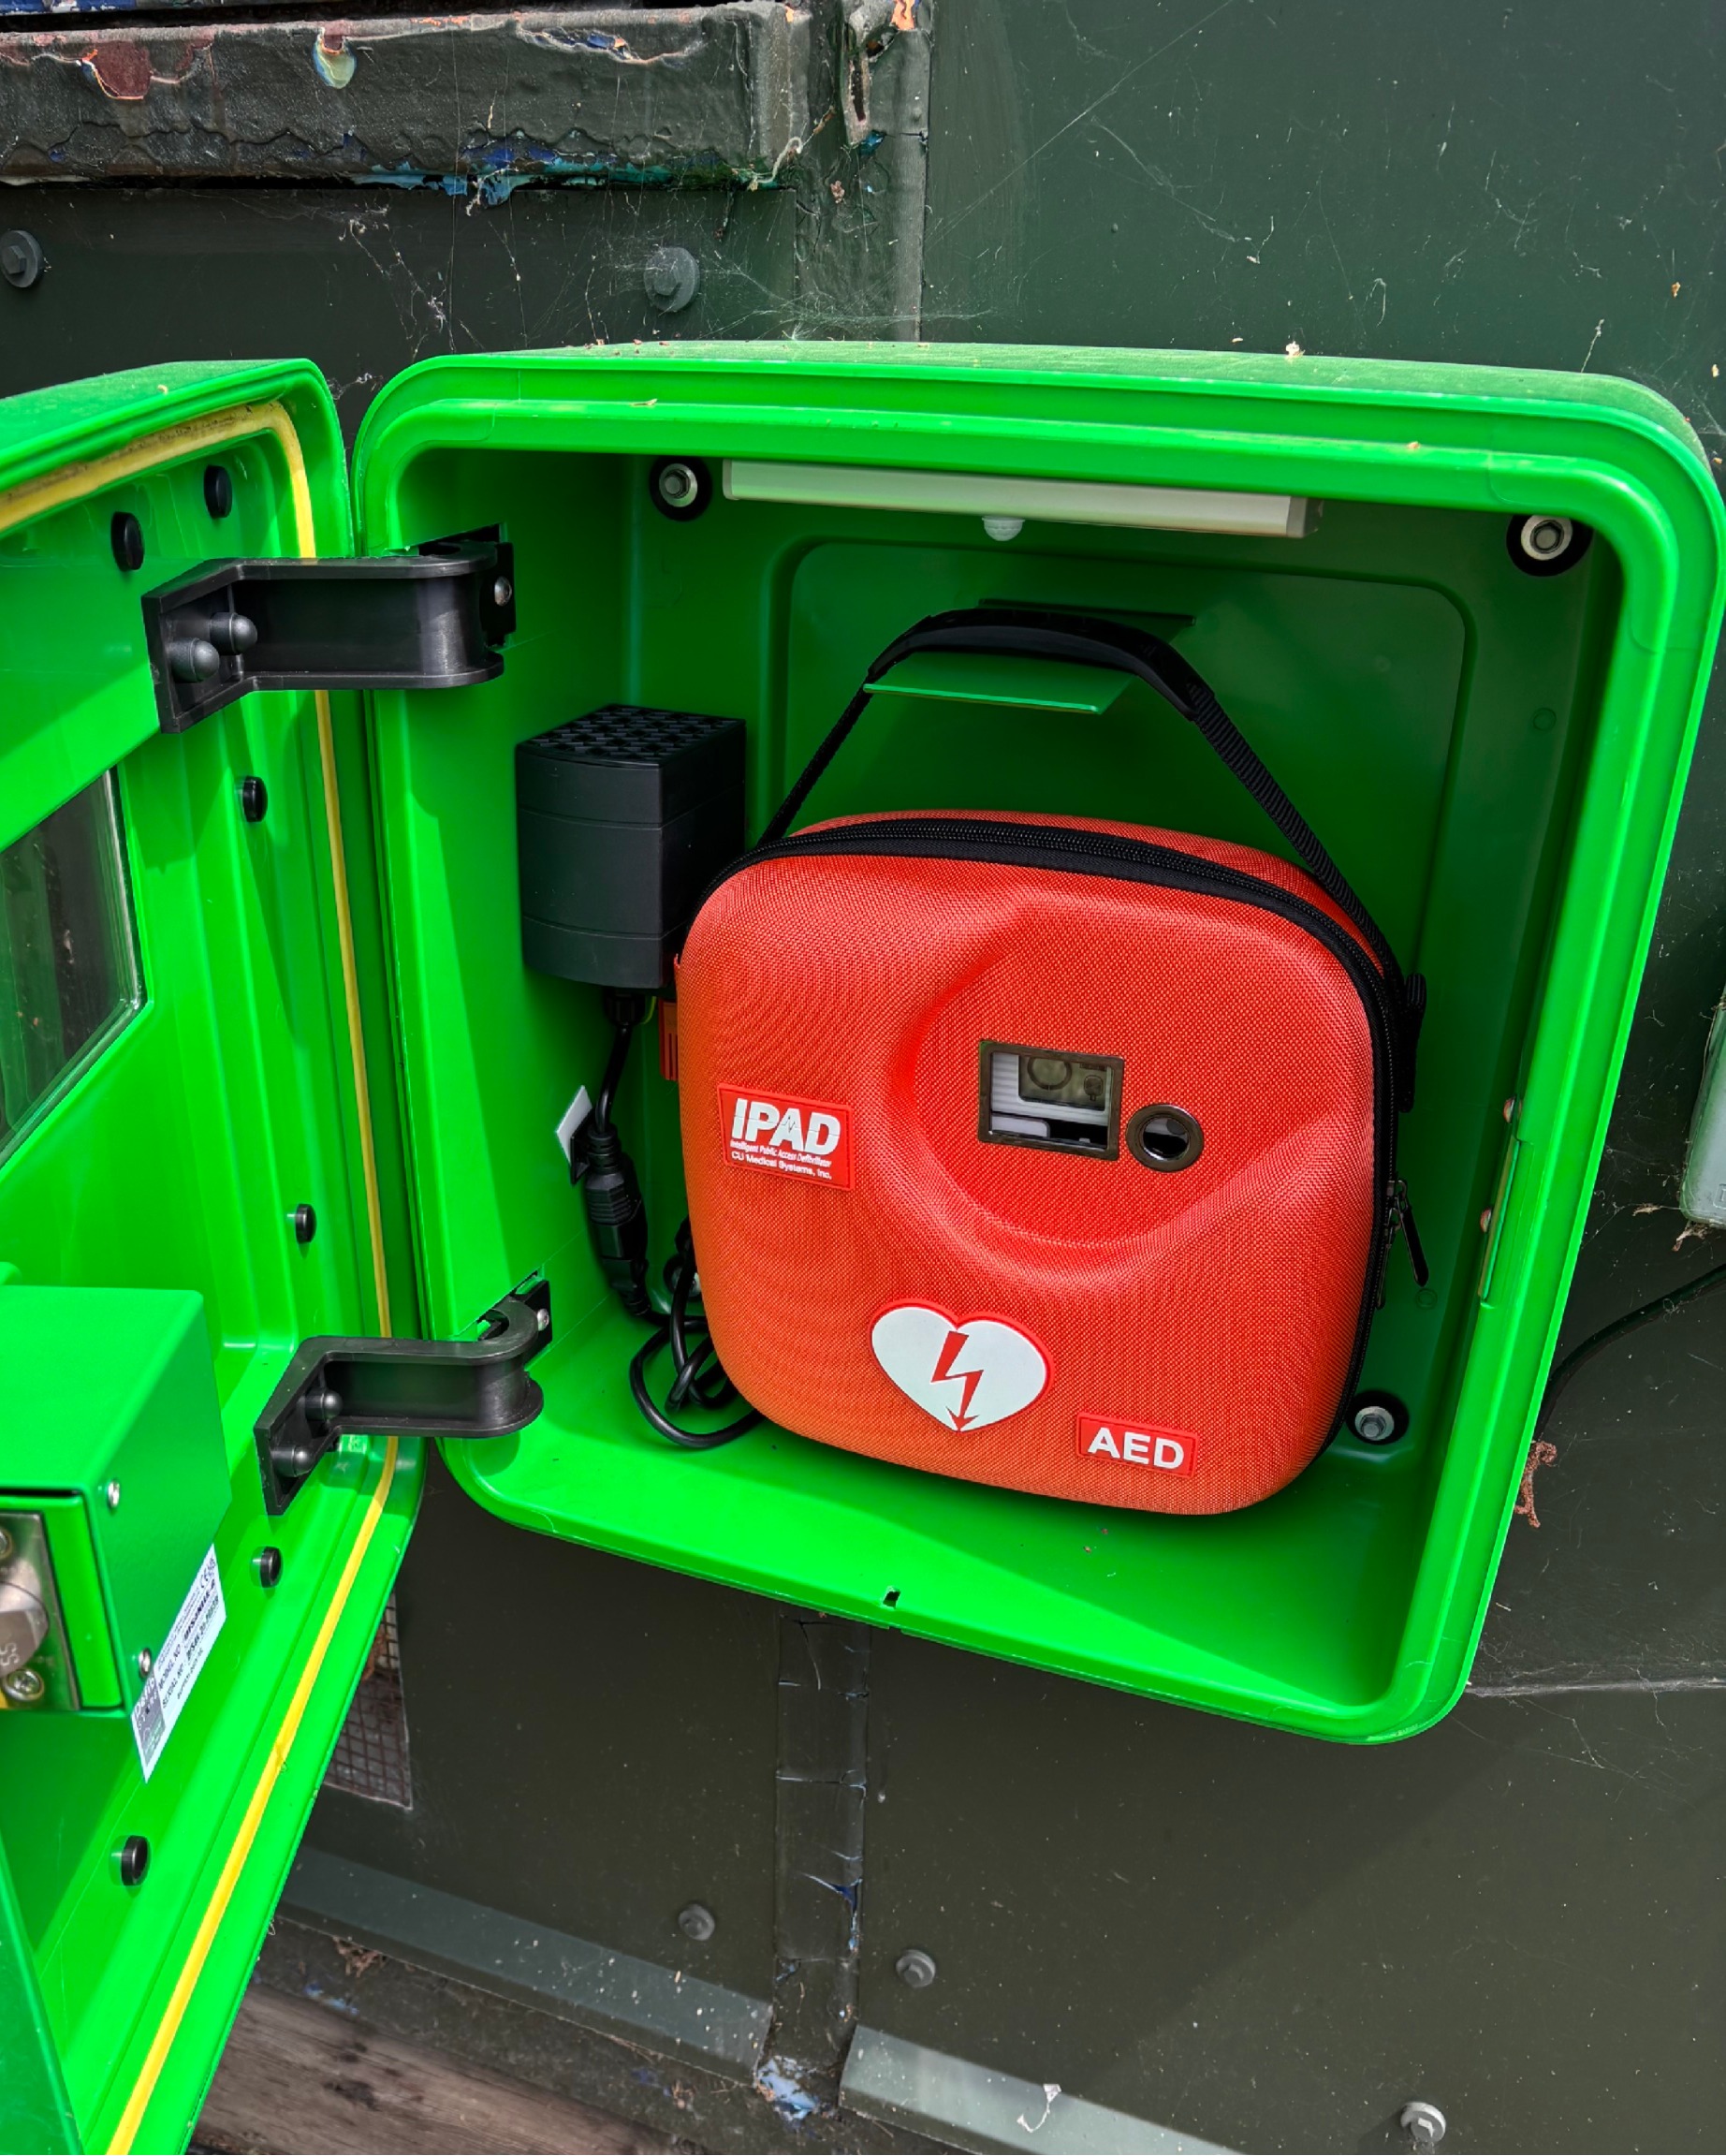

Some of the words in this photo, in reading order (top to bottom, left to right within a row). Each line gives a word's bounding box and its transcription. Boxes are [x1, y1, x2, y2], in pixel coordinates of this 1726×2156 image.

[731, 1097, 841, 1155] IPAD
[731, 1151, 744, 1161] CU
[745, 1154, 778, 1167] Medical
[778, 1160, 816, 1177] Systems,
[759, 1145, 778, 1157] Public
[778, 1149, 797, 1161] Access
[1087, 1427, 1185, 1470] AED
